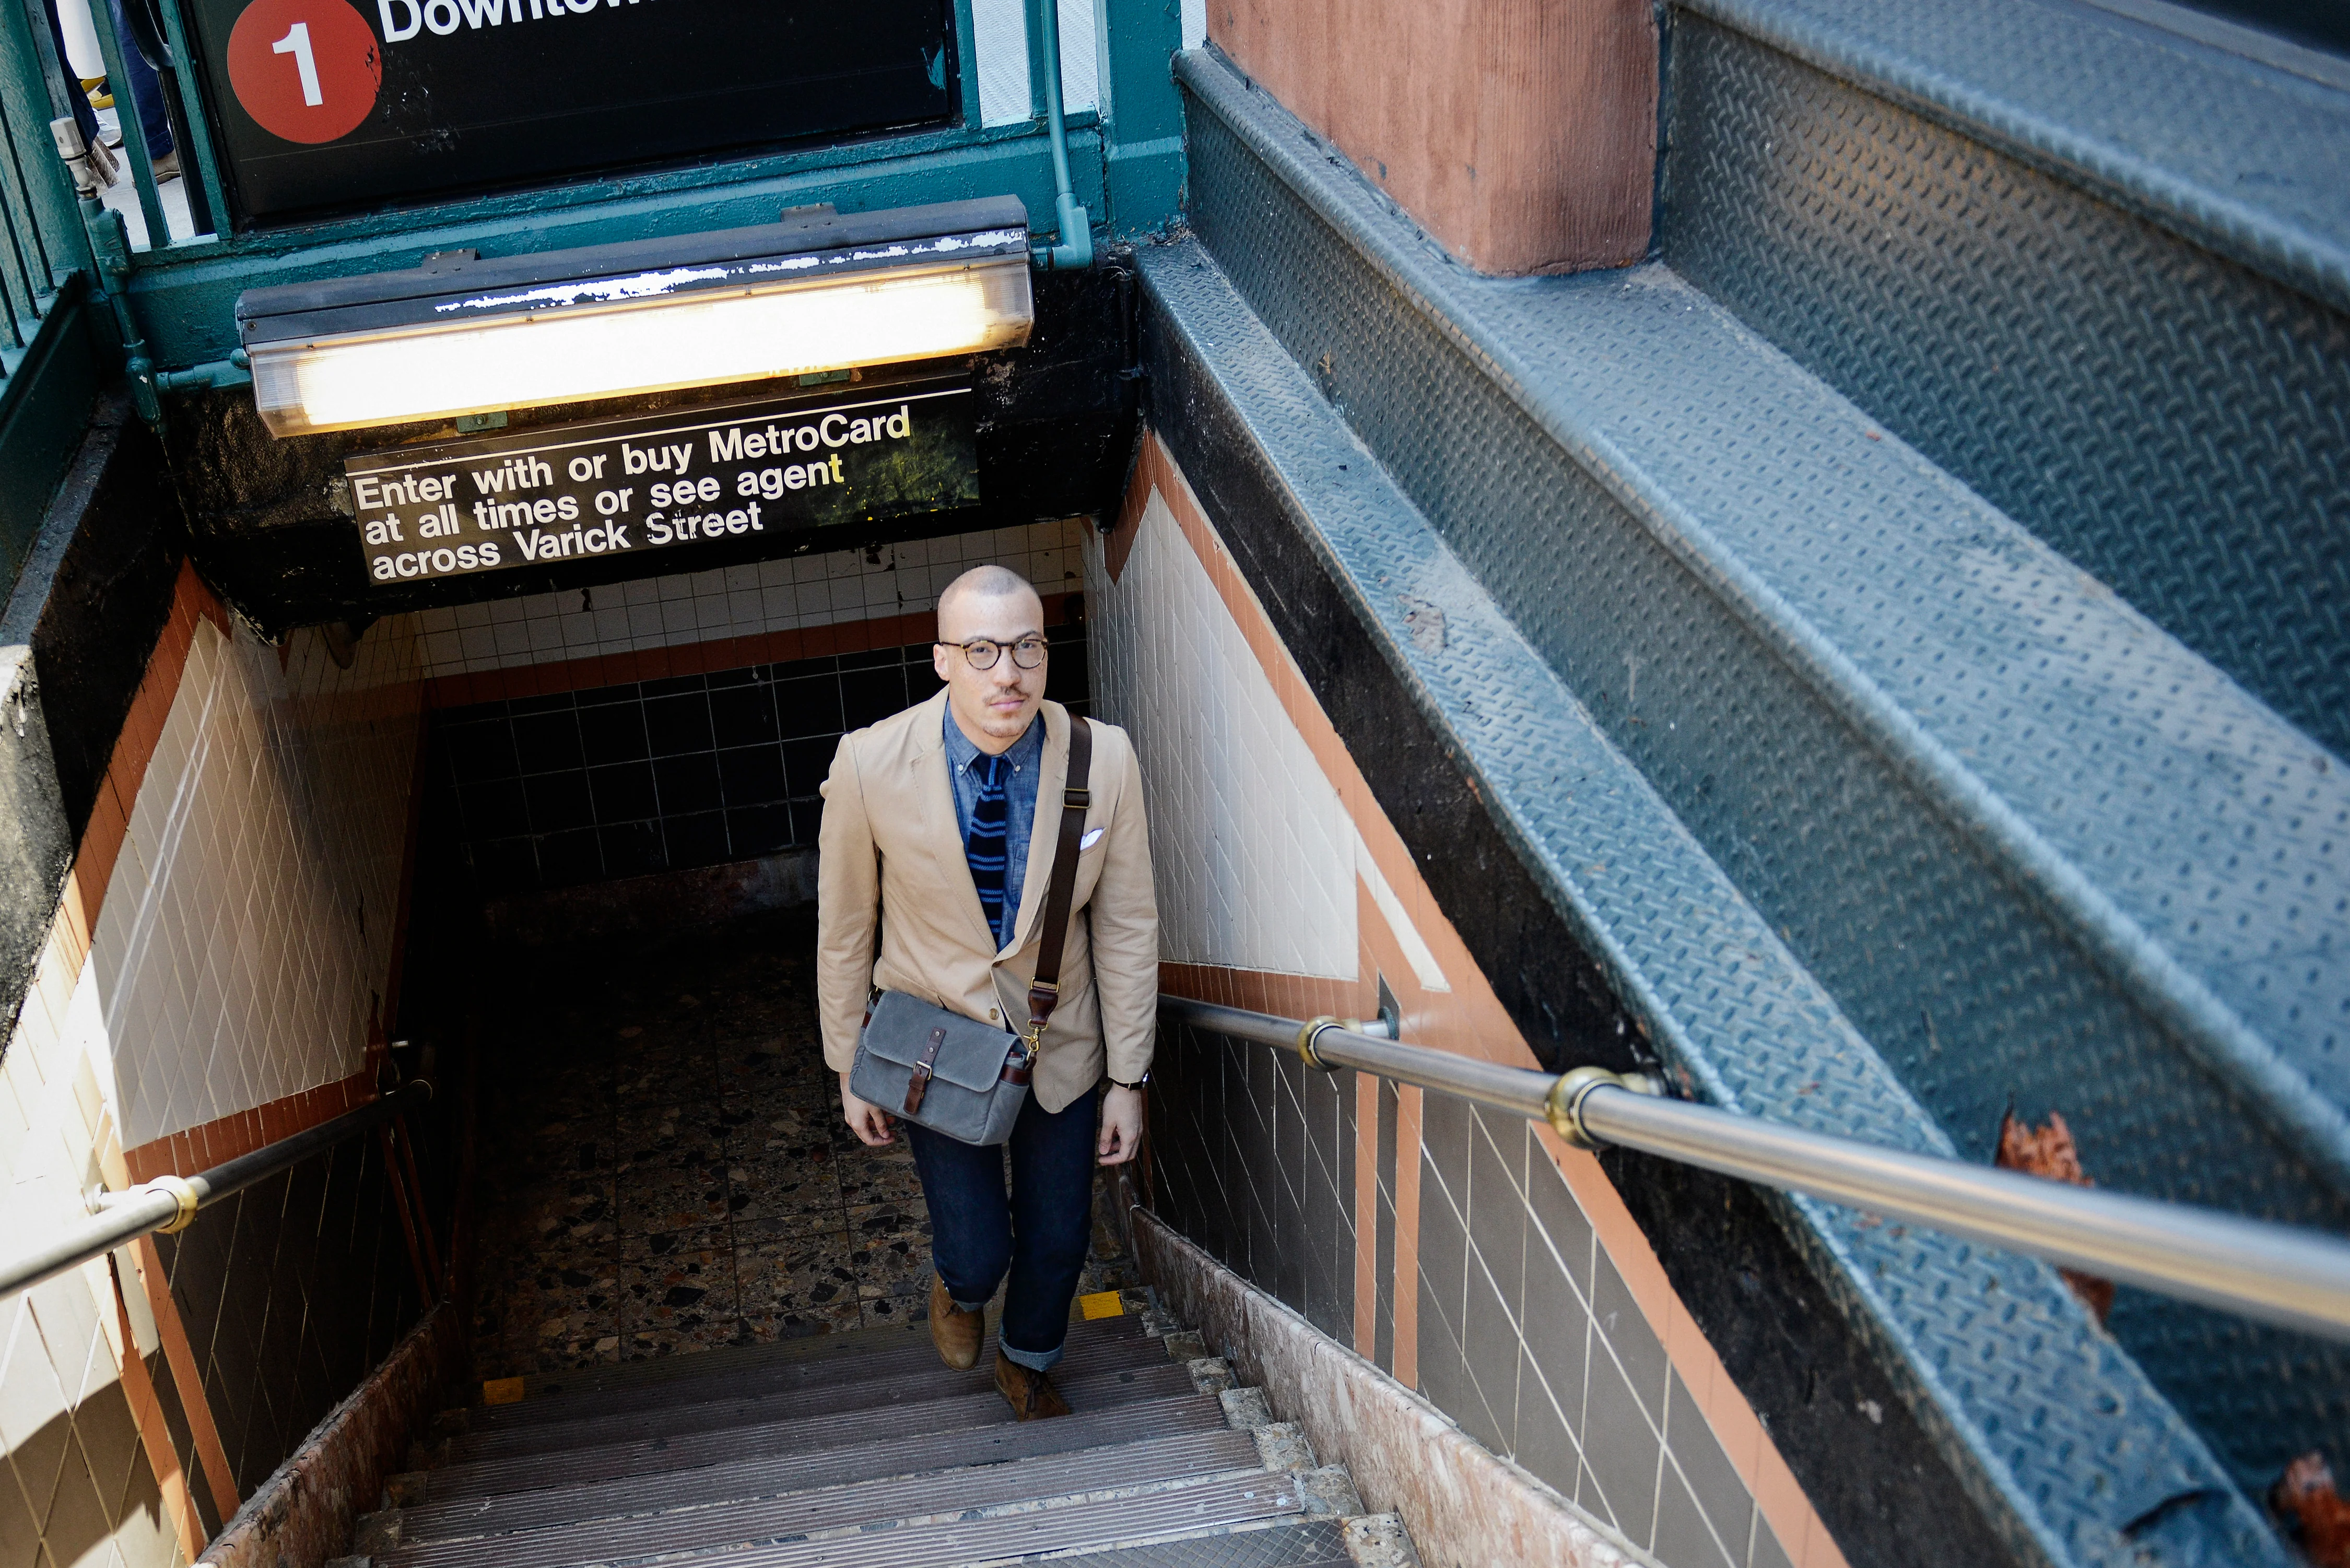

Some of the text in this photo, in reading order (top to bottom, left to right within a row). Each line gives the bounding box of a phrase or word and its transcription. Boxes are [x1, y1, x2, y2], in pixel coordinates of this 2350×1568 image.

[272, 22, 323, 107] 1
[354, 405, 910, 510] Enter with or buy MetroCard
[365, 453, 845, 545] at all times or see agent
[373, 501, 763, 580] across Varick Street
